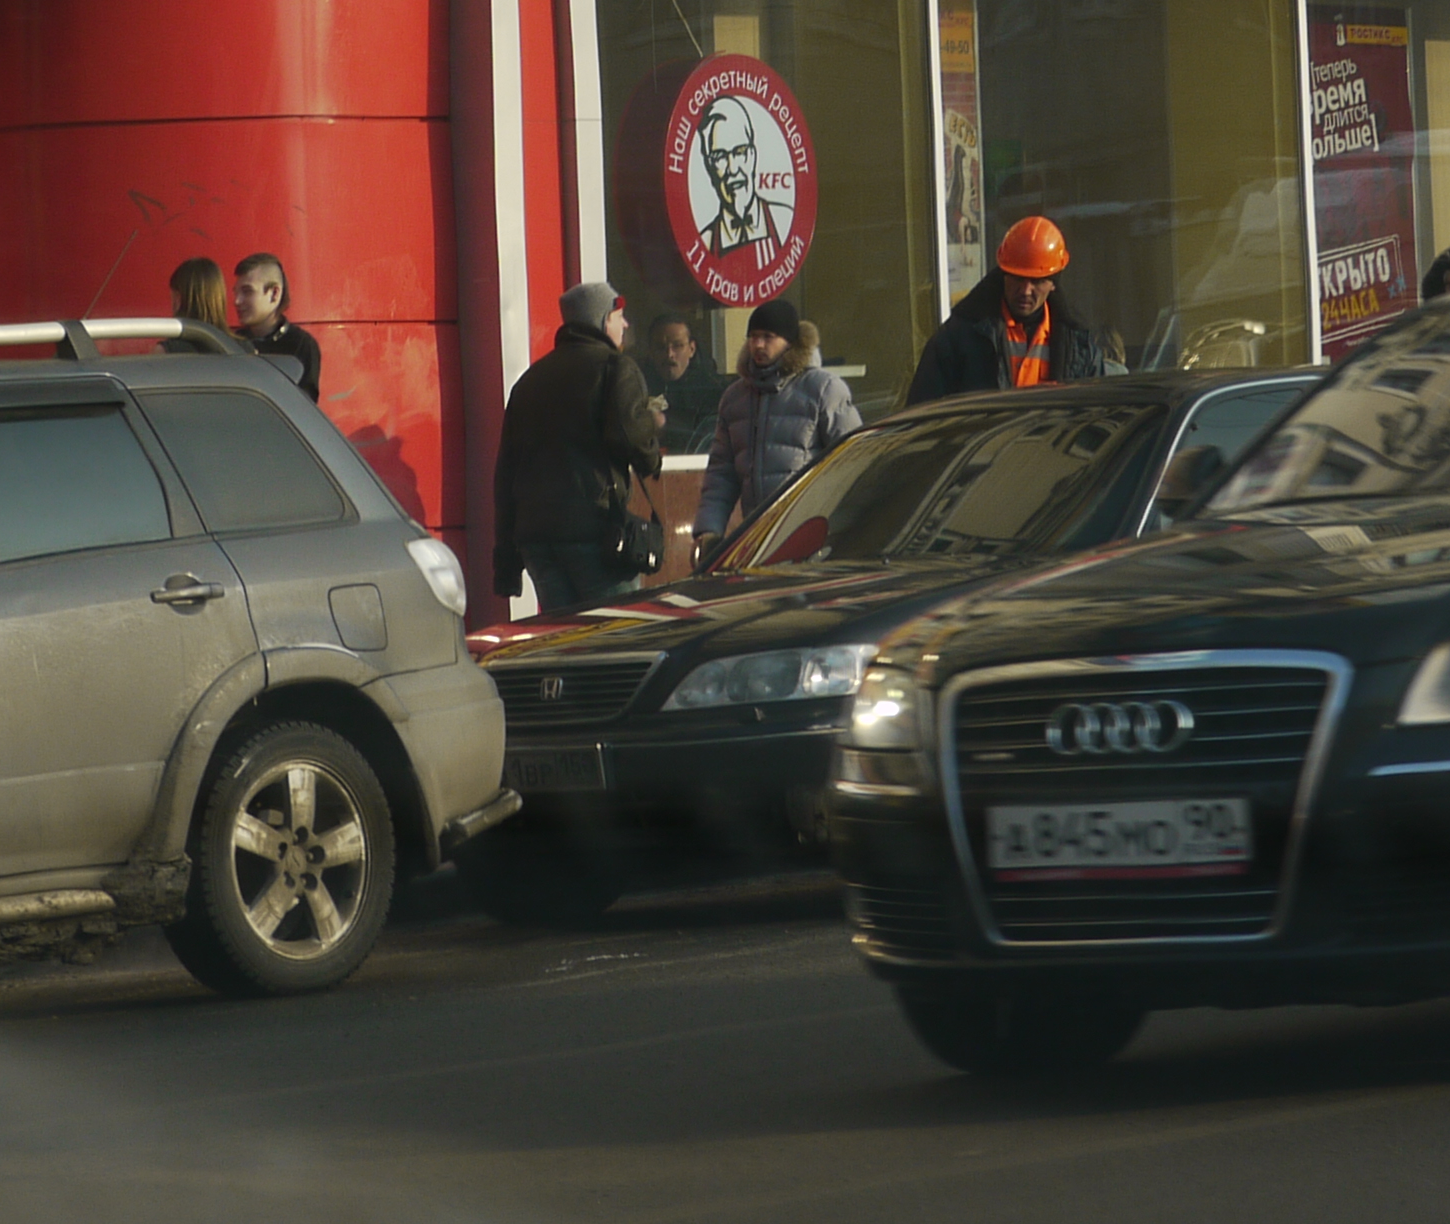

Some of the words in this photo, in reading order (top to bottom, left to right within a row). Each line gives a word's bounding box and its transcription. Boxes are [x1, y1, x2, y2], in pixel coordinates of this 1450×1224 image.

[668, 117, 692, 174] Наш
[688, 70, 769, 114] секретный
[768, 93, 809, 174] рецепт
[1310, 78, 1367, 125] ремя
[1323, 103, 1369, 135] длится
[1312, 113, 1380, 160] ольше]
[758, 172, 792, 190] KFC
[686, 240, 706, 273] 11
[706, 268, 739, 302] трав
[743, 284, 754, 303] и
[758, 235, 805, 298] специй
[1319, 247, 1390, 300] КРЫТО
